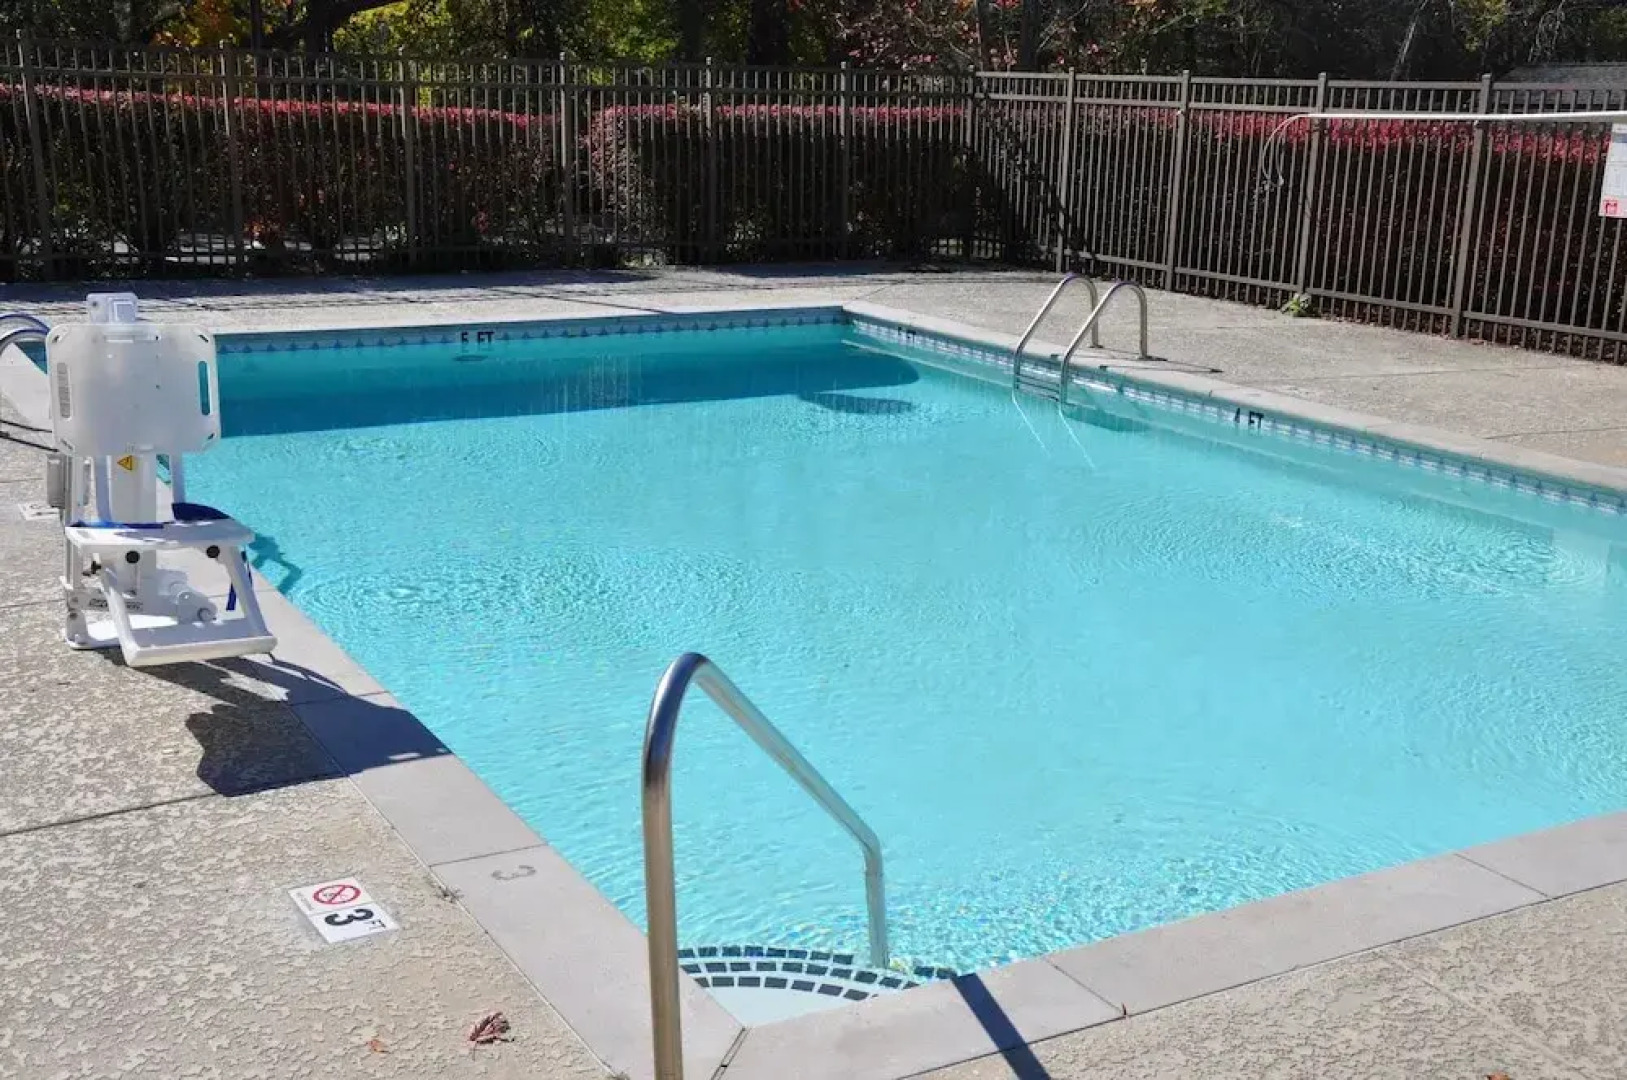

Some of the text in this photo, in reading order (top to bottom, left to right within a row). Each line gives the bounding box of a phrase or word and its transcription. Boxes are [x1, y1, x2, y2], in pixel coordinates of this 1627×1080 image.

[477, 331, 495, 344] FT
[1248, 411, 1264, 429] FT
[324, 908, 374, 926] 3
